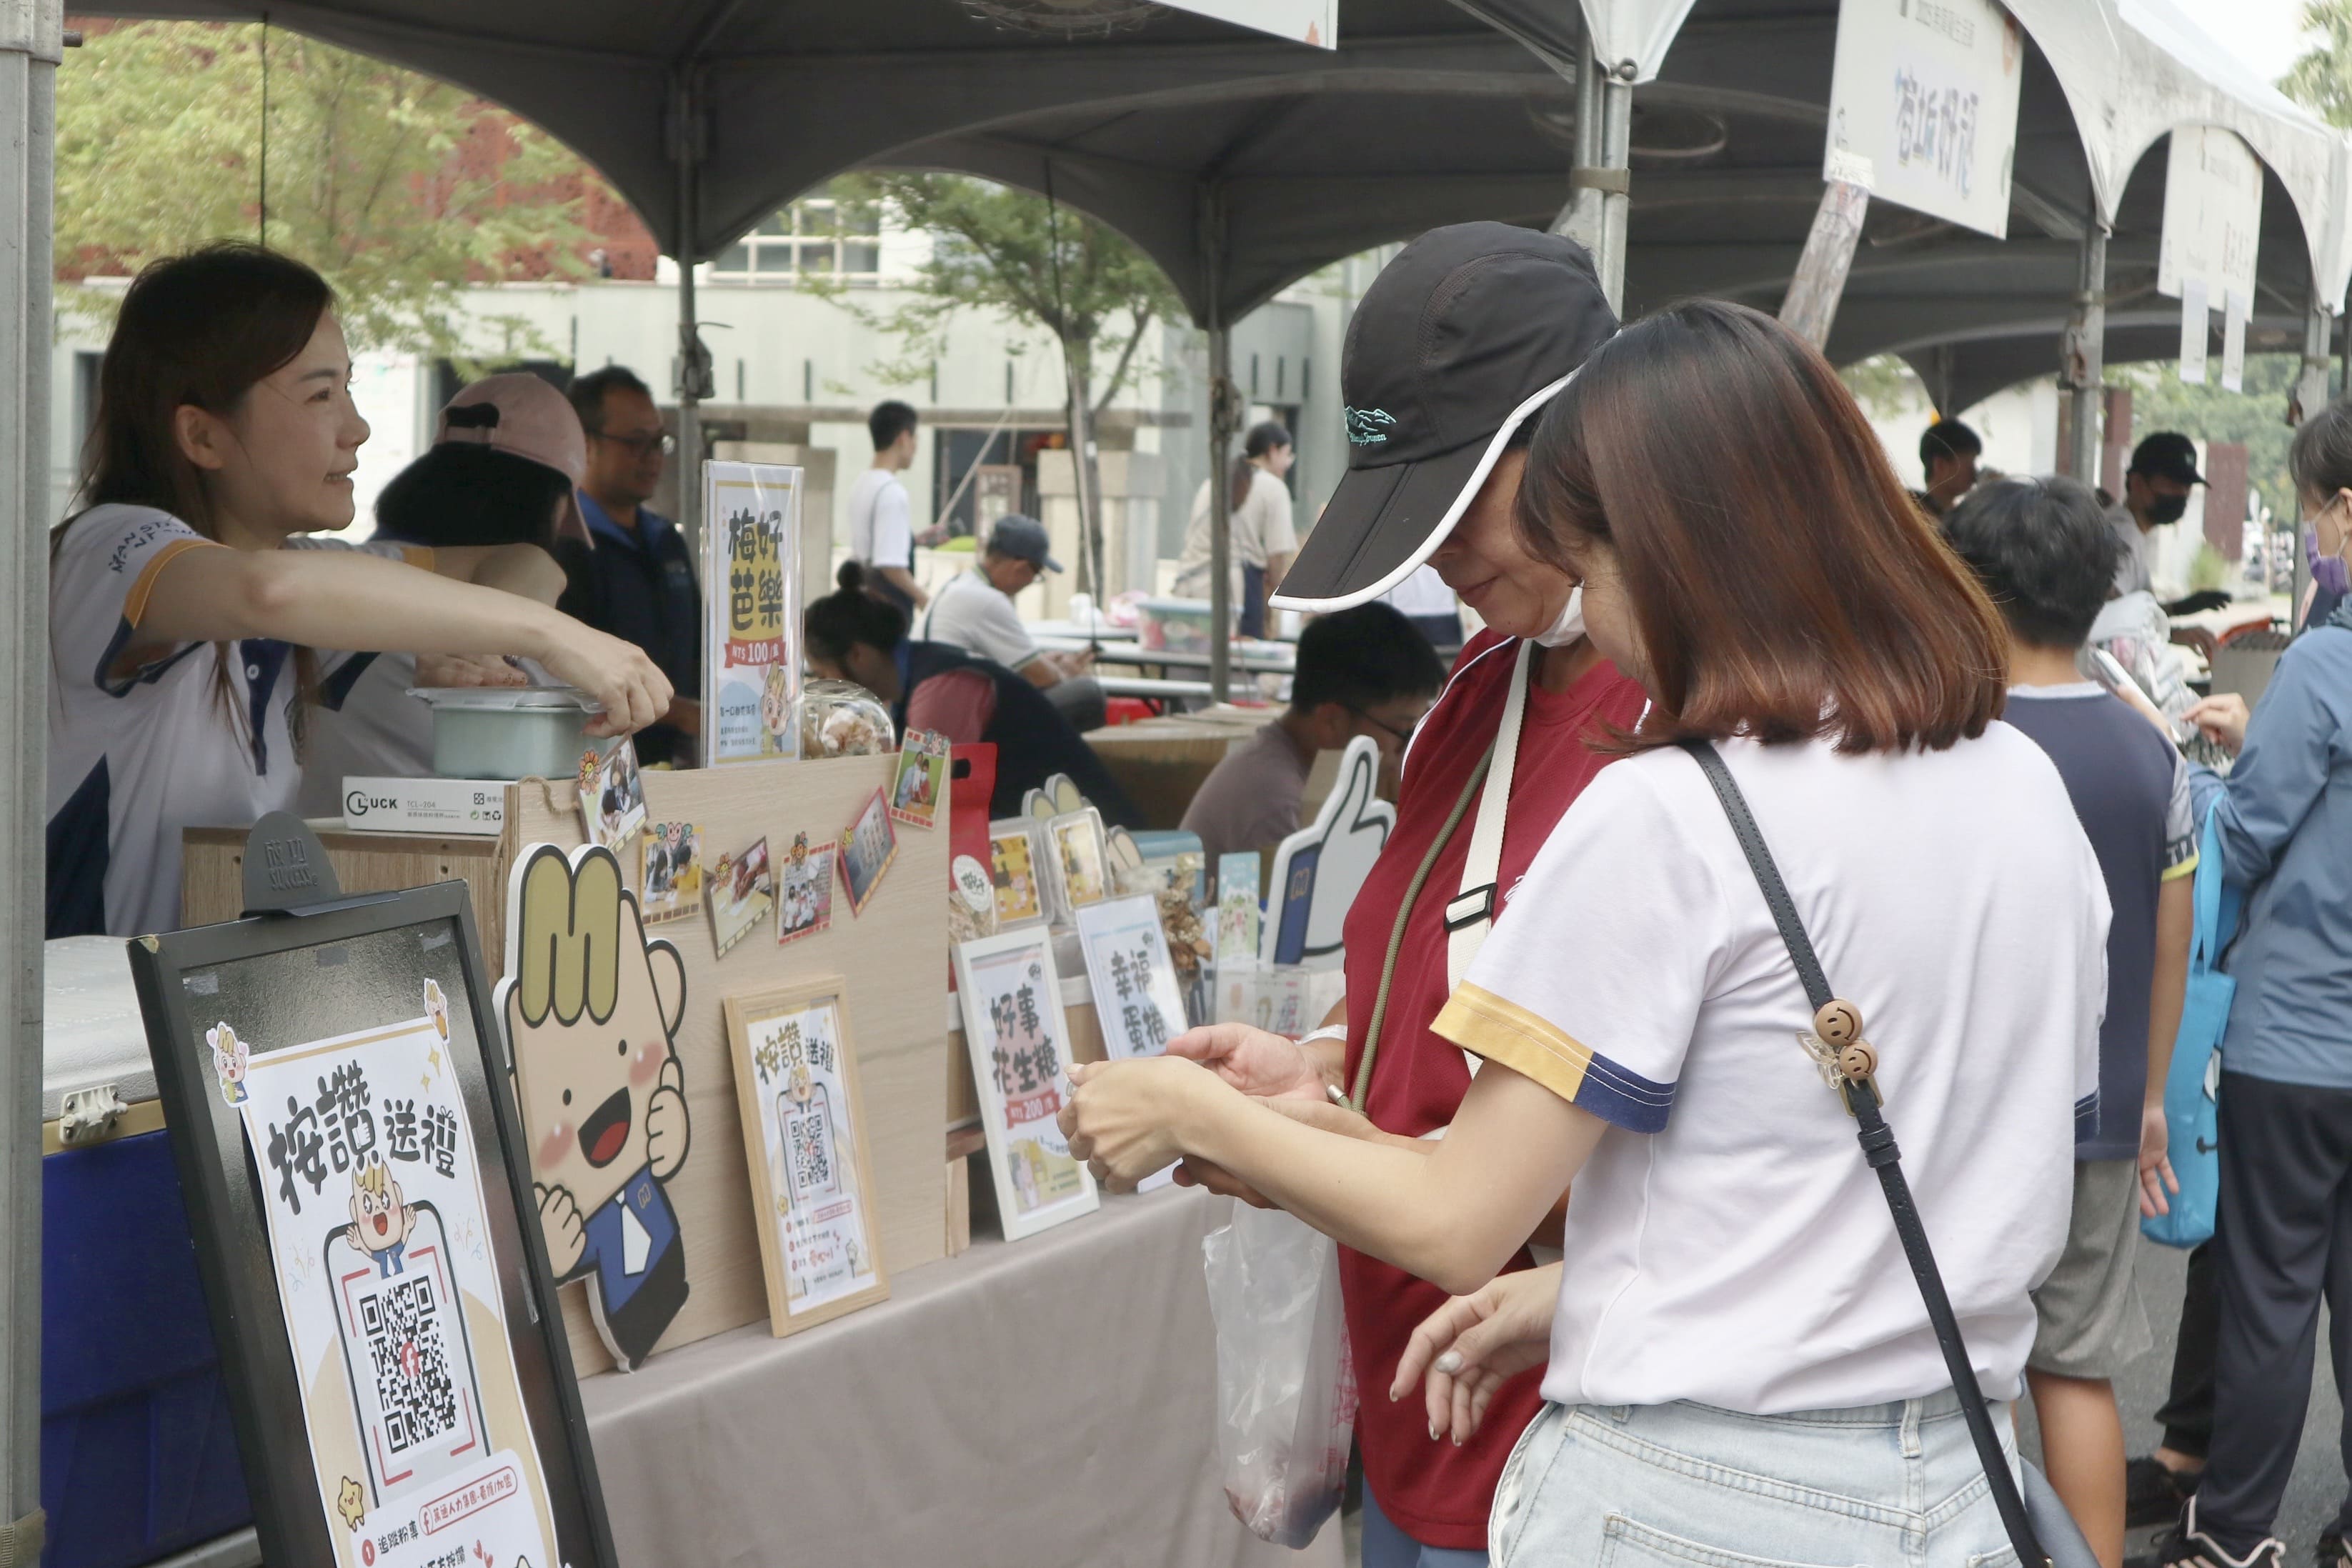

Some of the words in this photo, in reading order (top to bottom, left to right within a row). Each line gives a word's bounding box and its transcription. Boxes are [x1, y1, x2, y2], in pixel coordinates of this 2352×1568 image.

[728, 507, 783, 564] 梅好
[730, 567, 783, 631] 芭樂
[748, 642, 768, 663] 100
[1111, 949, 1155, 1001] 幸福
[991, 983, 1040, 1039] 好事
[992, 1035, 1059, 1096] 花生糖
[1023, 1098, 1043, 1120] 200
[377, 1519, 419, 1555] 追蹤粉專
